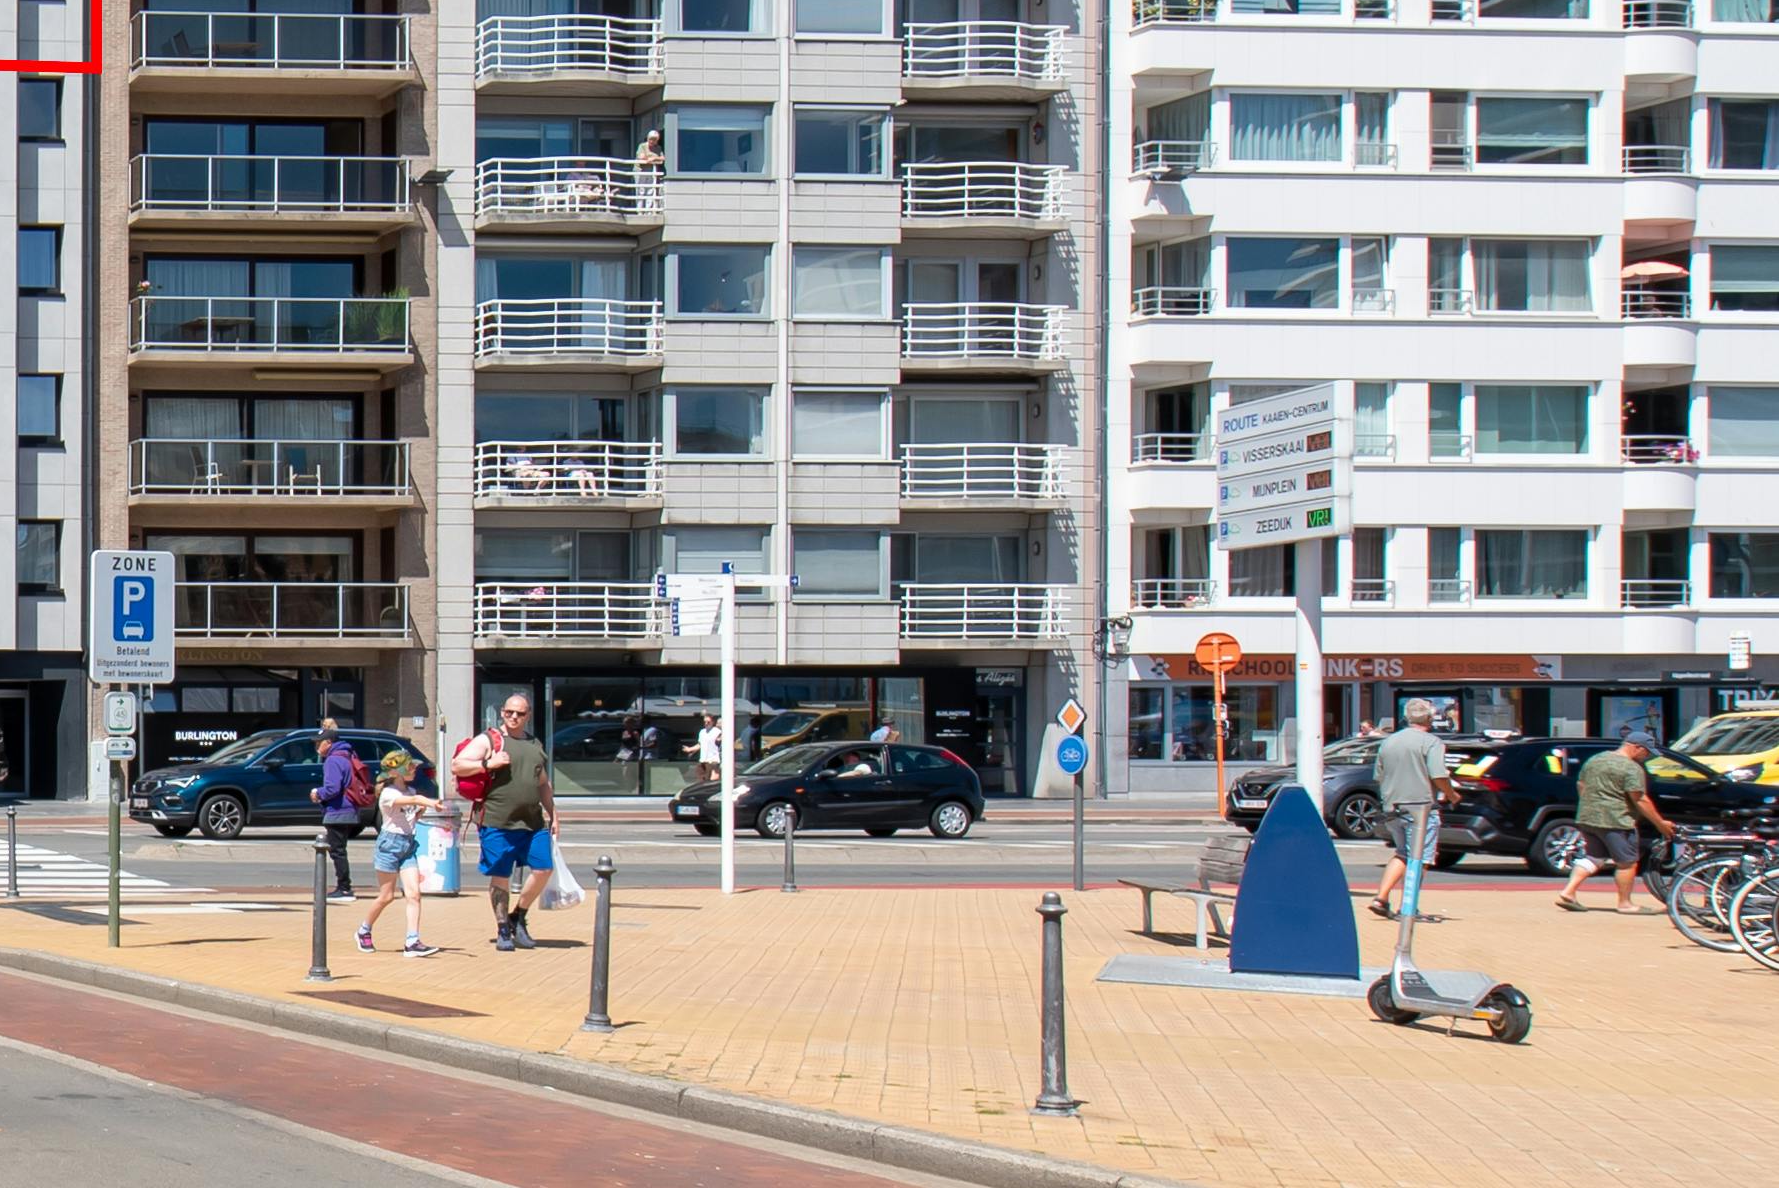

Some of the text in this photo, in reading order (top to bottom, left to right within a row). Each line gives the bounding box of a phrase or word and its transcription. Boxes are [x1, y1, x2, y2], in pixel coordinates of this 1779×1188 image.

[1223, 413, 1258, 433] ROUTE
[1242, 439, 1305, 463] VISSERSKAAI
[112, 557, 157, 572] ZONE
[122, 581, 146, 616] P
[116, 646, 150, 656] Betalend
[177, 651, 263, 661] RLINGTON
[175, 731, 237, 740] BURLINGTON
